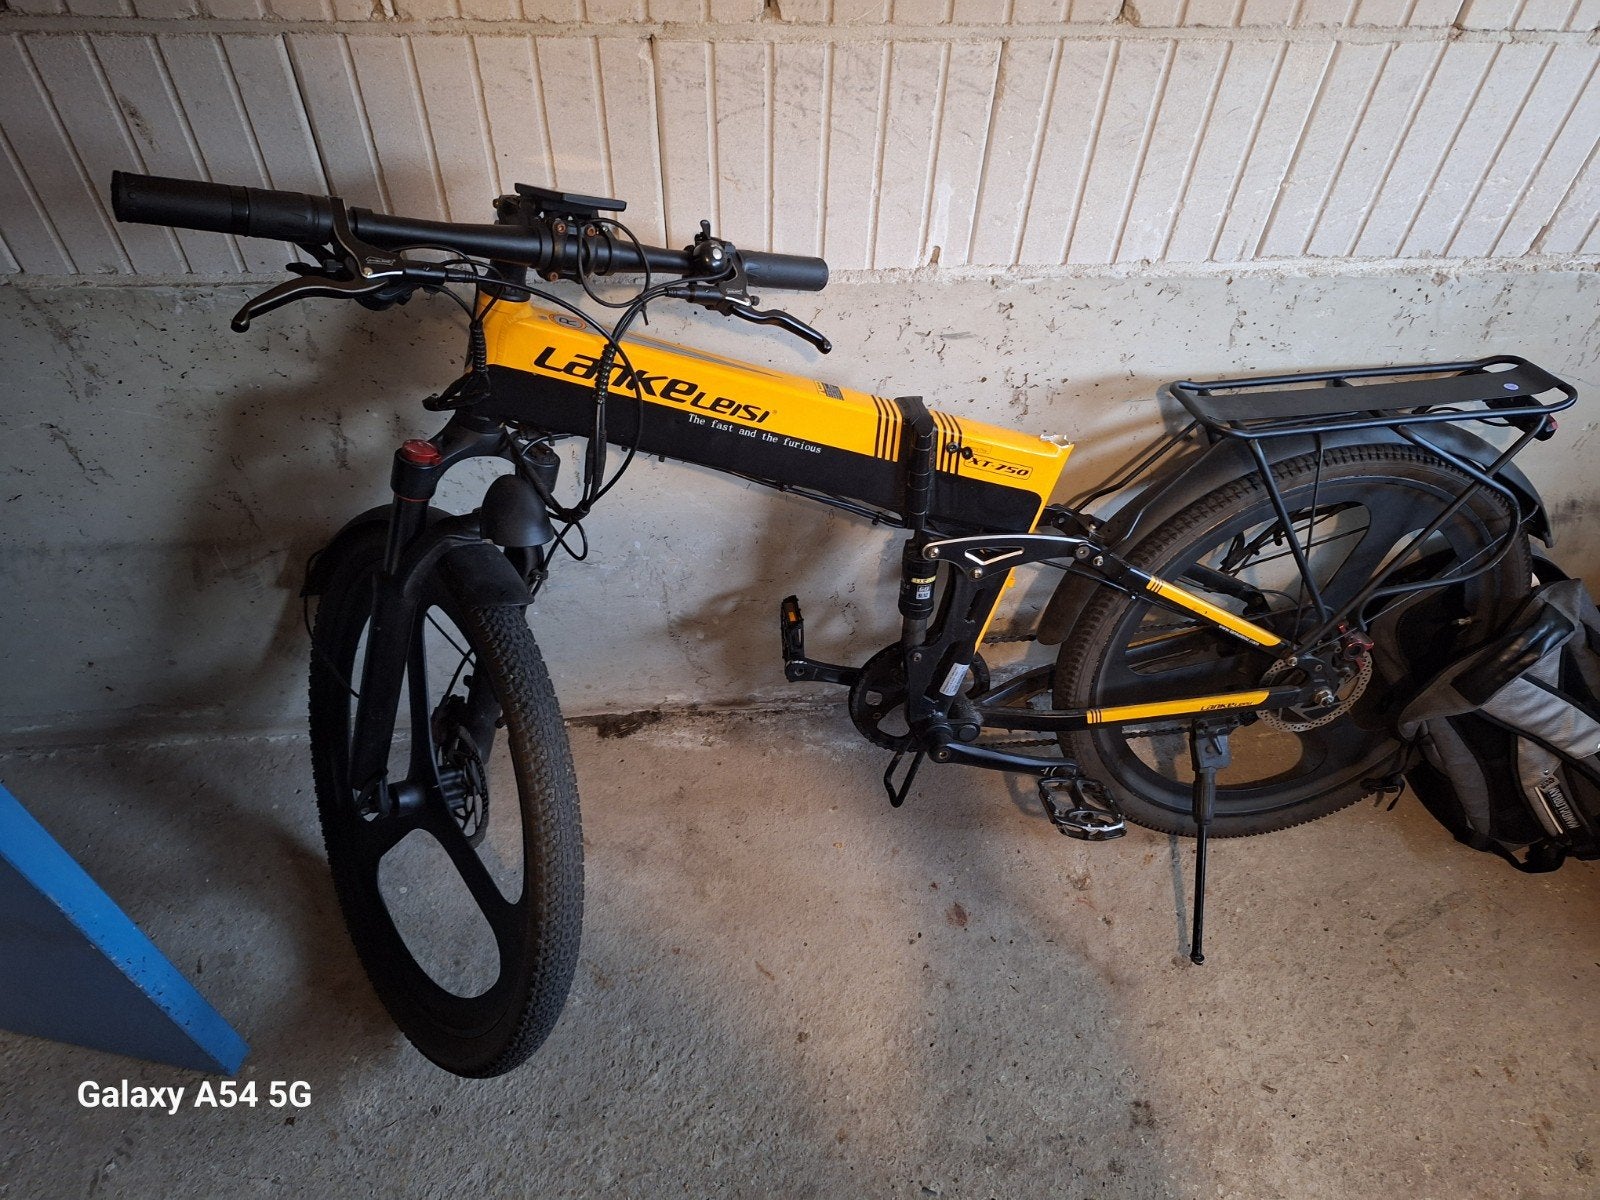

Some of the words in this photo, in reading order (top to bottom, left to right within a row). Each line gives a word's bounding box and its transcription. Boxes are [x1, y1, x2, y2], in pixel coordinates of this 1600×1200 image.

[688, 413, 706, 425] The
[711, 419, 733, 433] fast
[739, 428, 757, 438] and
[762, 433, 778, 443] the
[782, 437, 822, 453] furious
